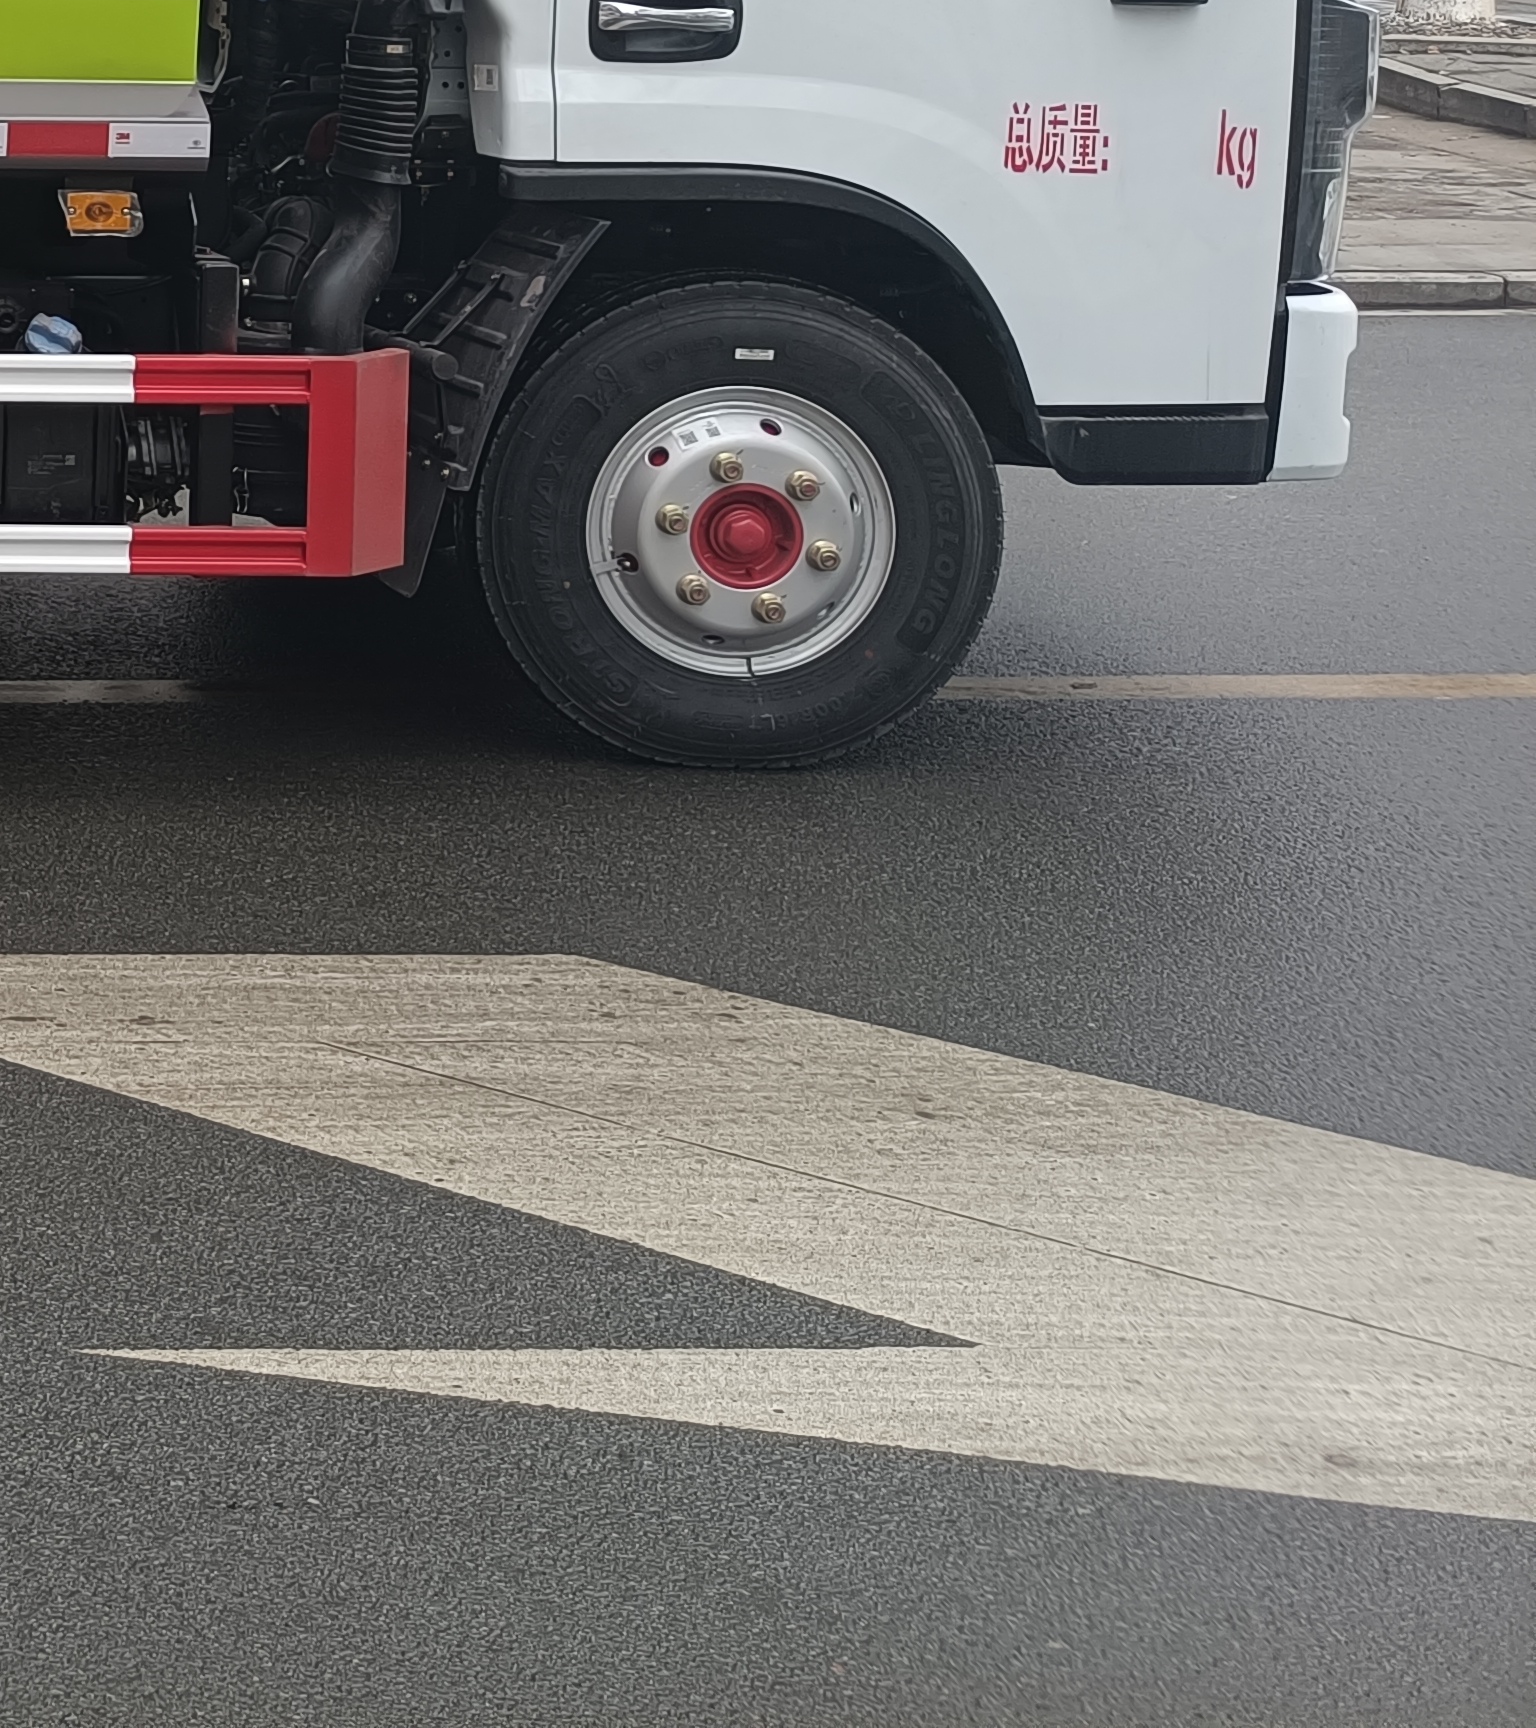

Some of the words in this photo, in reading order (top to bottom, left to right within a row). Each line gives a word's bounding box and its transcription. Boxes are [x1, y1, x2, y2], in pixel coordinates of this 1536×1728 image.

[1003, 101, 1109, 175] 总质量:
[1216, 108, 1258, 190] kg
